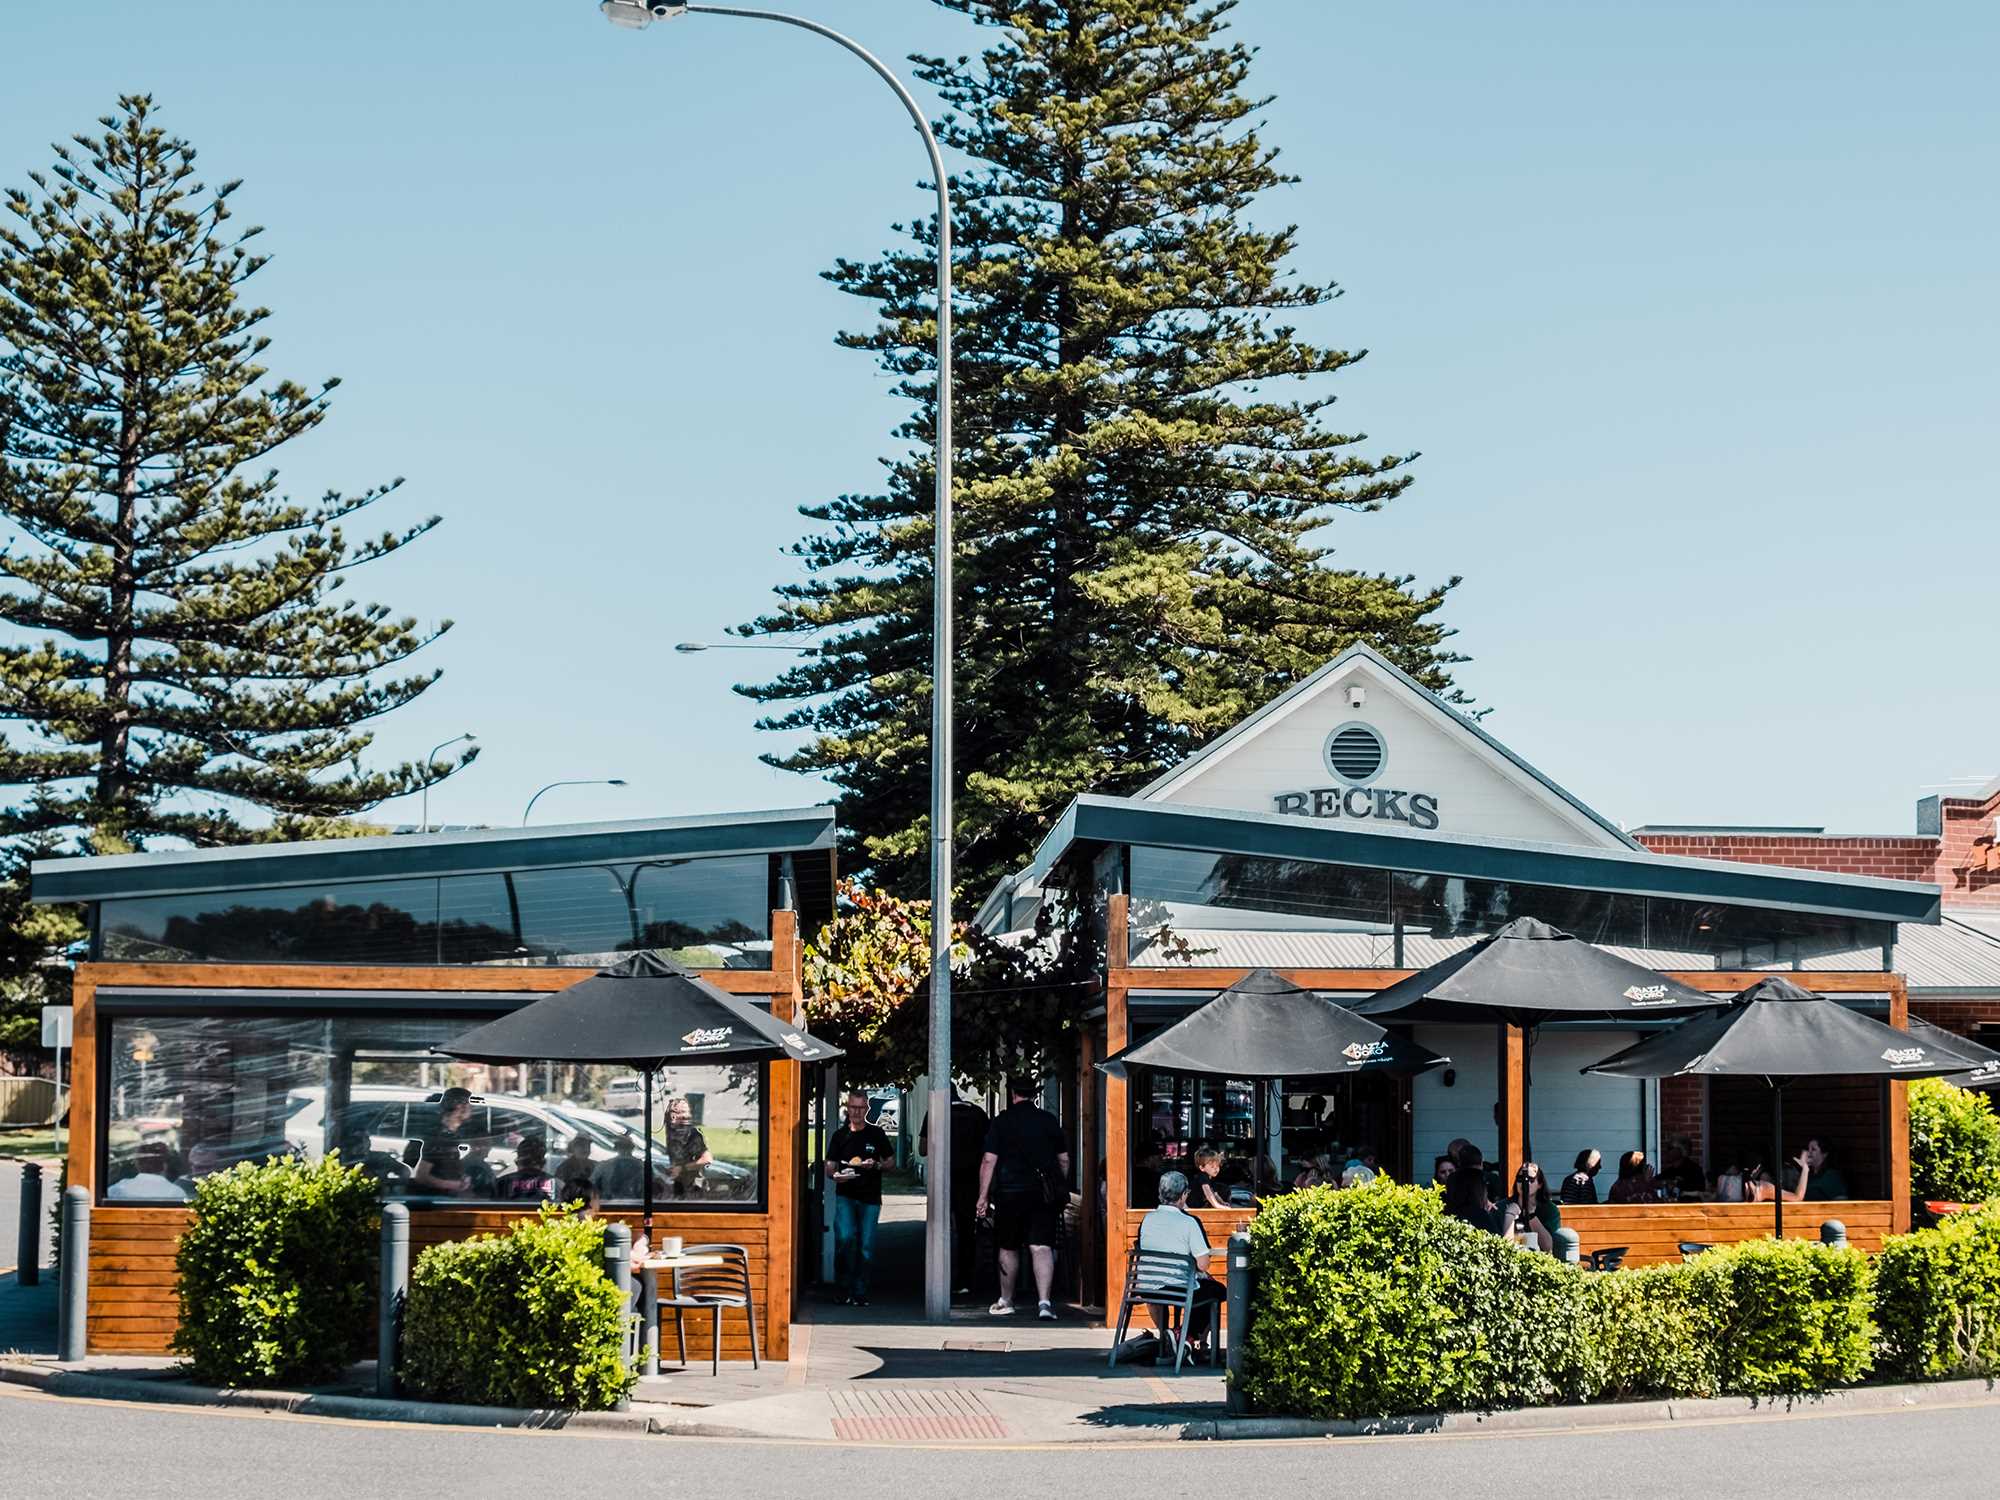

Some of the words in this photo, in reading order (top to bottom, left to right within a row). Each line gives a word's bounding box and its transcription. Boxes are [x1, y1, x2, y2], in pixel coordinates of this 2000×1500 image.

[1274, 786, 1440, 830] BECKS
[695, 1026, 733, 1038] PIAZZA
[1353, 1041, 1389, 1051] PIAZZA
